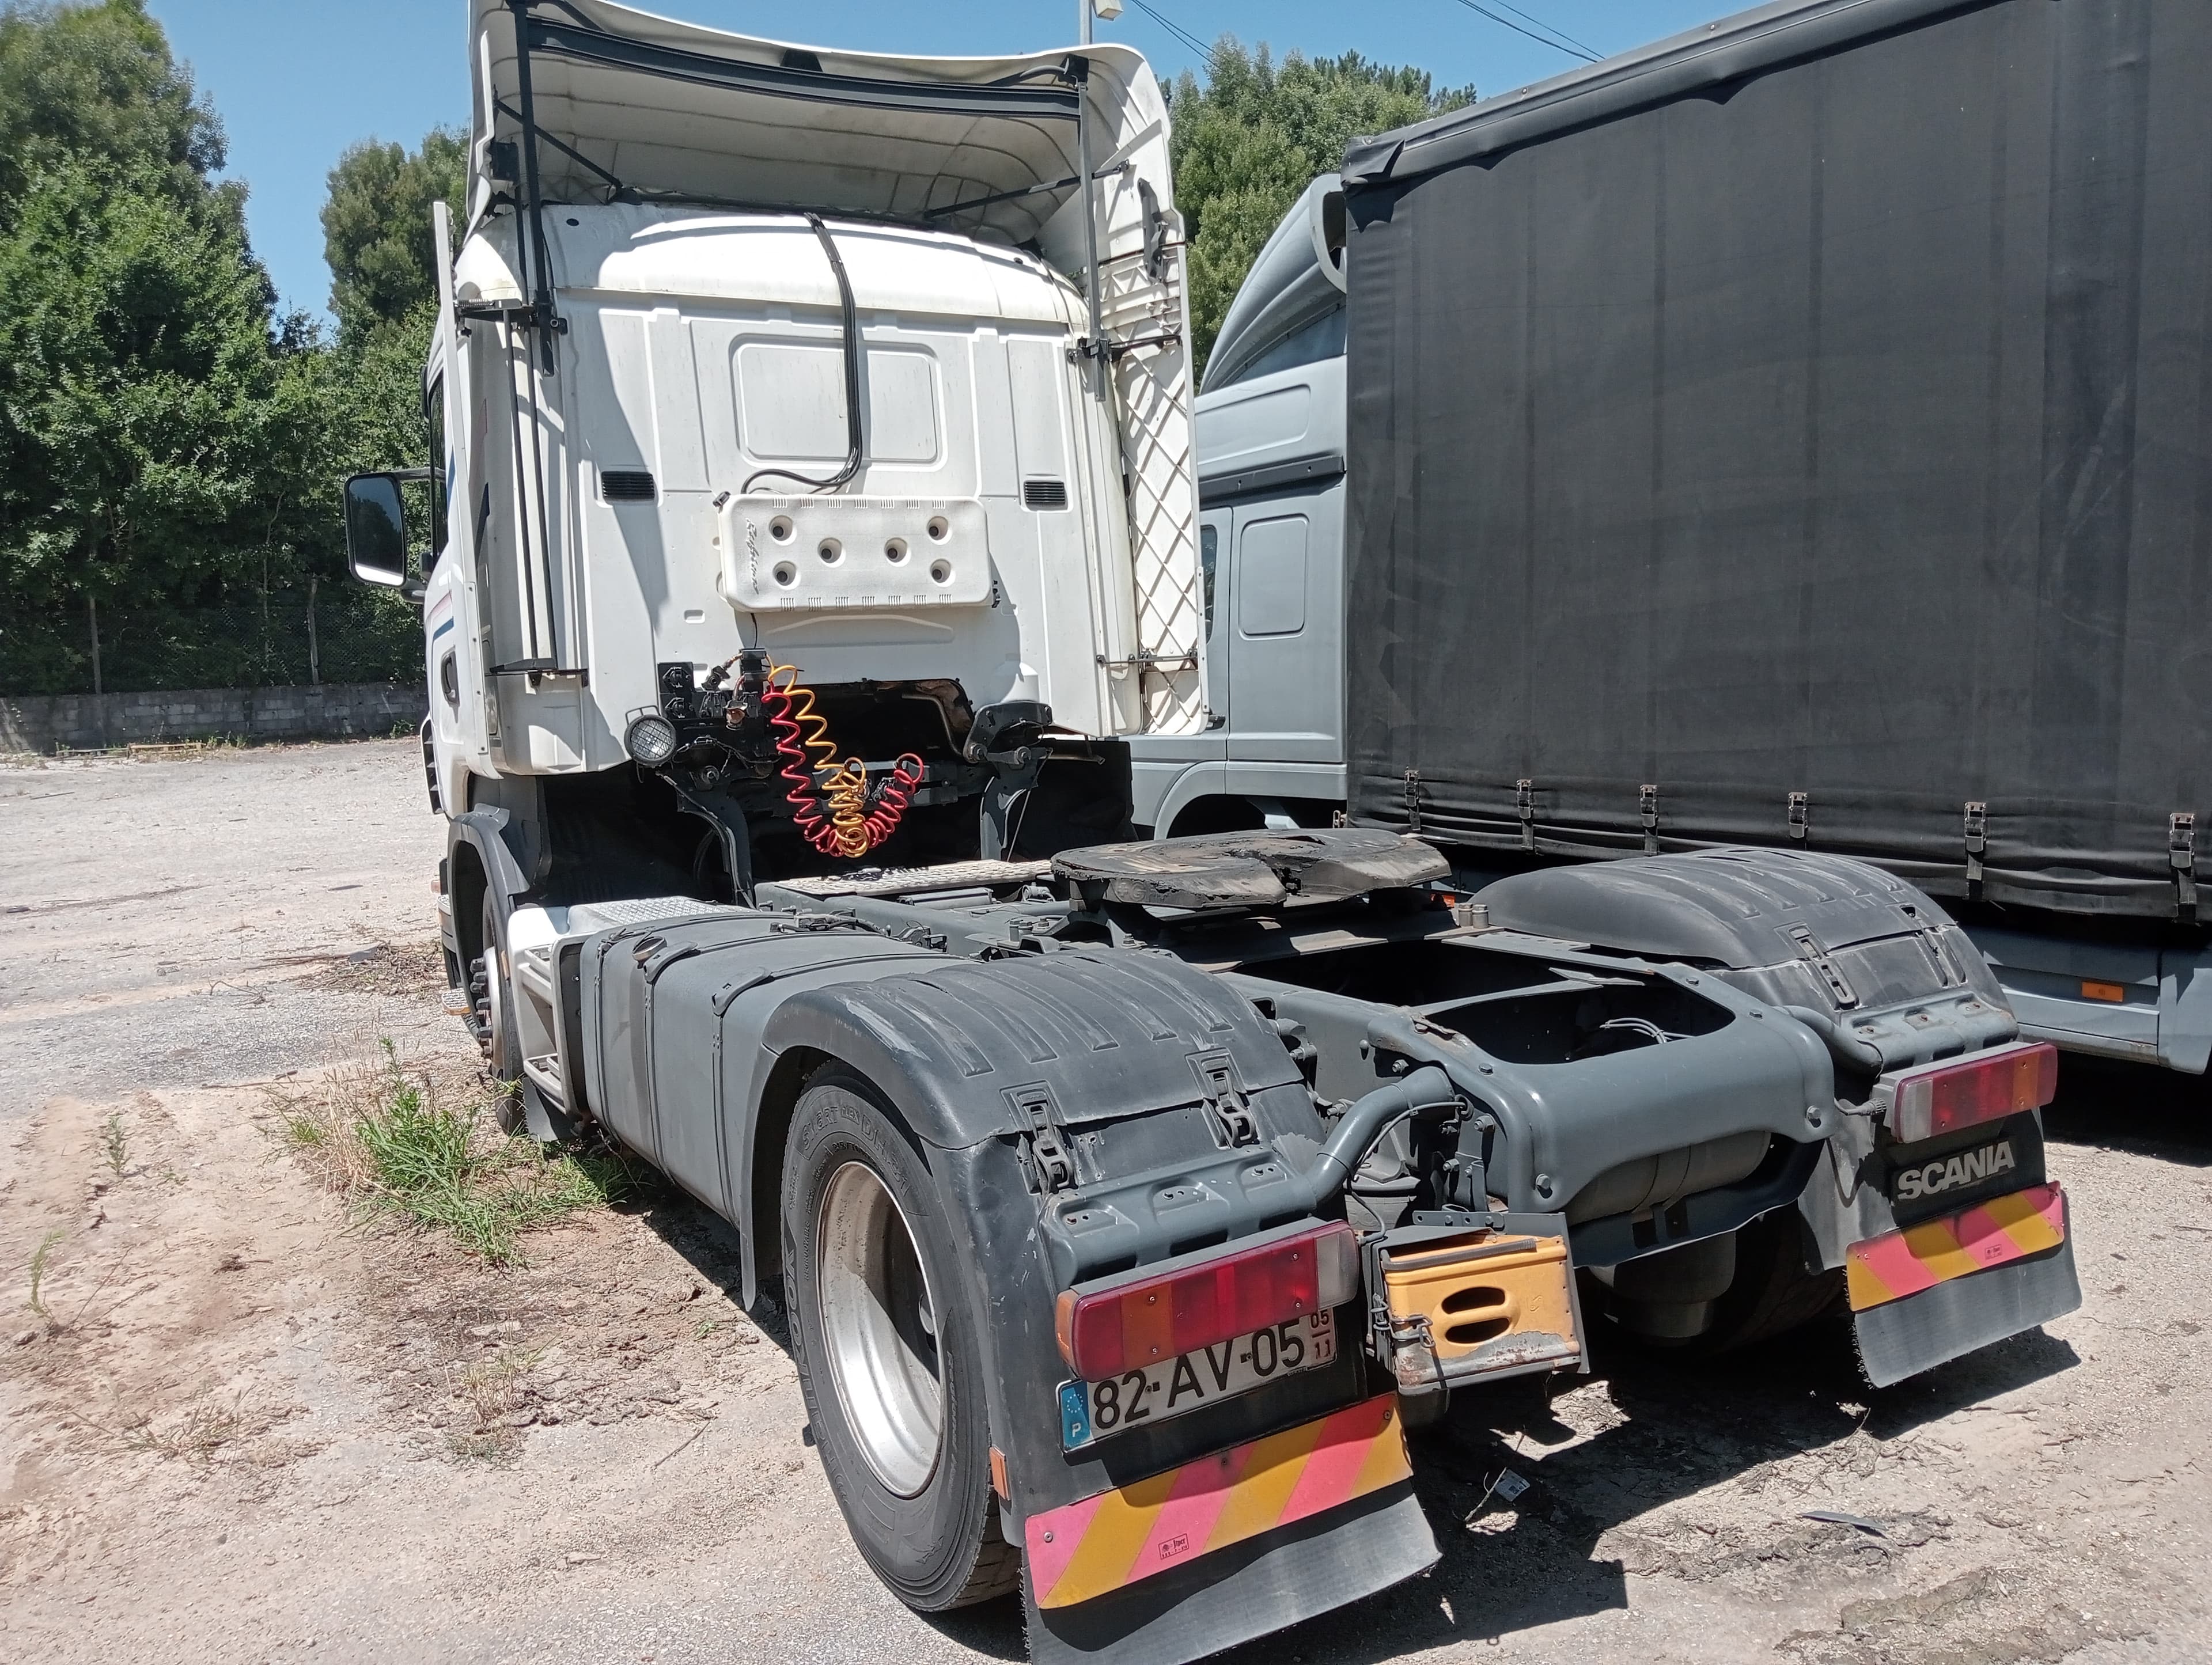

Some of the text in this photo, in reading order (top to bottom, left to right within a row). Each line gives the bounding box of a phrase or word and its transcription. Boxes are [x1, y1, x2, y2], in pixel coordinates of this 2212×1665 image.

[1897, 1141, 2015, 1200] SCANIA
[1310, 1309, 1330, 1329] 05
[1314, 1339, 1331, 1360] 11
[1071, 1423, 1081, 1438] P
